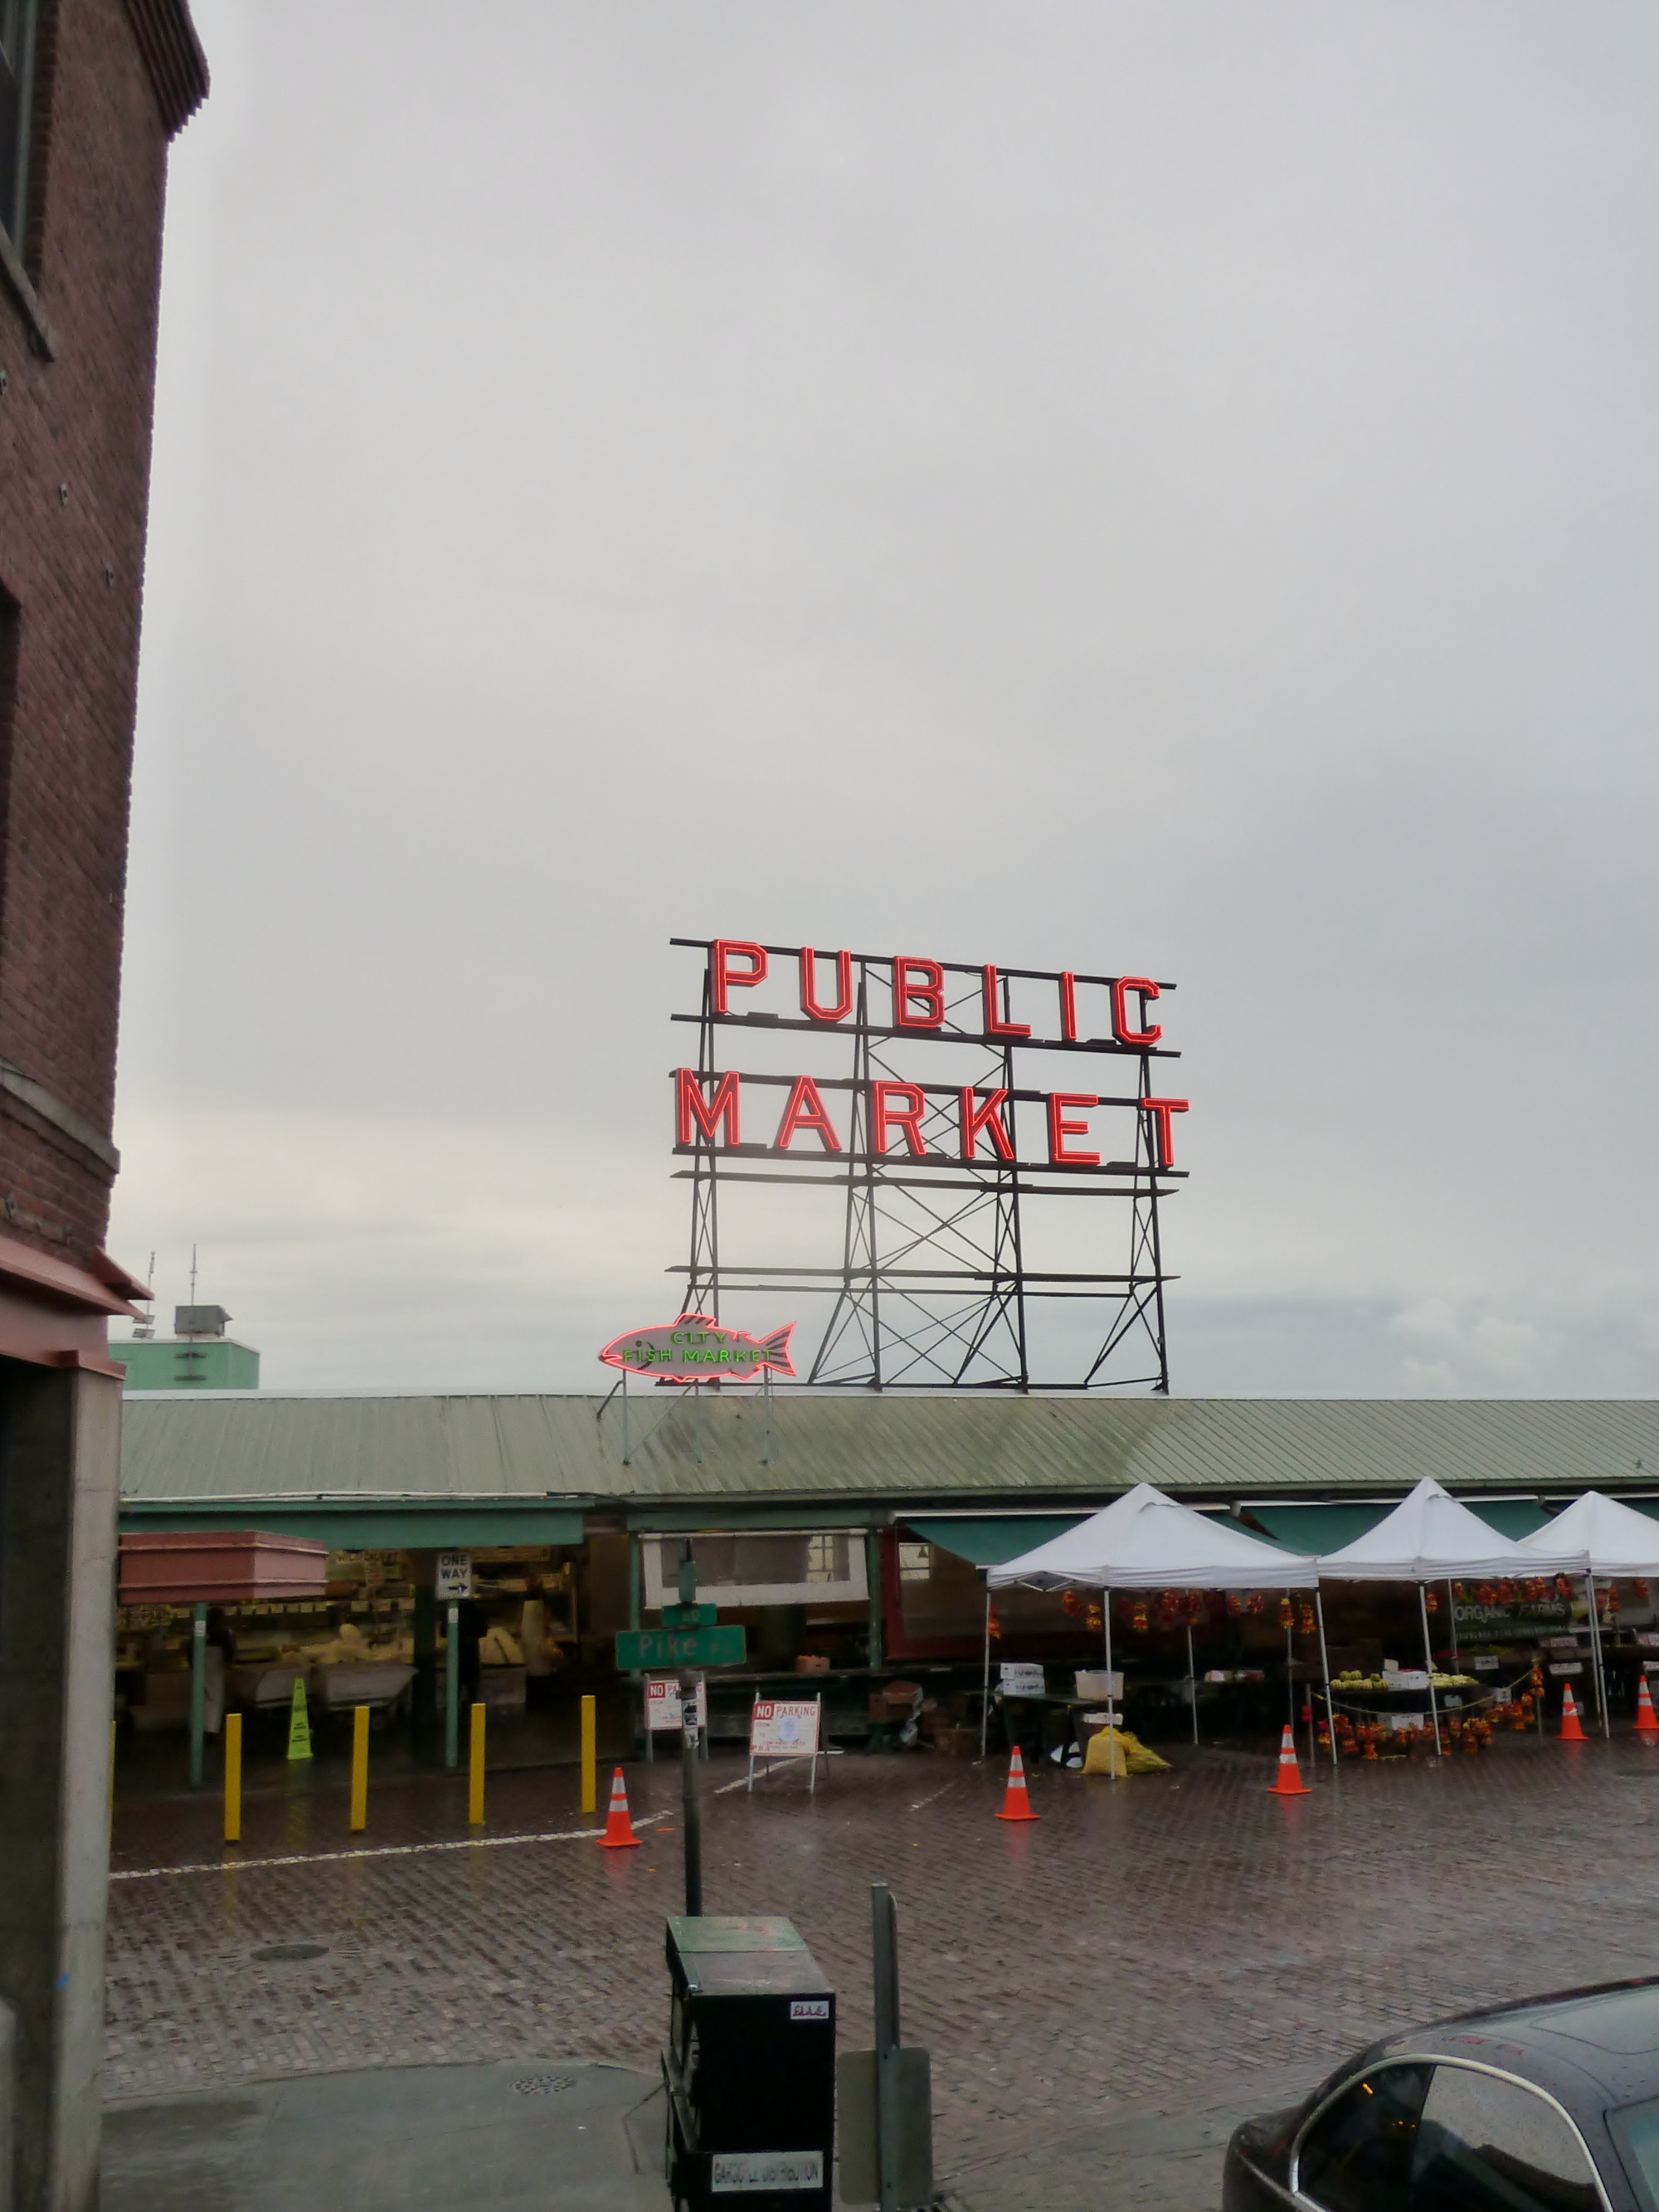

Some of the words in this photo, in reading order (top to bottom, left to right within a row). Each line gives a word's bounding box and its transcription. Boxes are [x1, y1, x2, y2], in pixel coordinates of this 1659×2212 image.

[711, 938, 1163, 1045] PUBLIC
[674, 1067, 1190, 1167] MARKET
[671, 1331, 727, 1344] CITY
[622, 1349, 673, 1363] FISH
[683, 1349, 773, 1363] MARKET
[441, 1554, 468, 1566] ONE
[440, 1568, 468, 1579] WAY
[1455, 1605, 1514, 1623] ORGANC
[639, 1634, 698, 1659] Pike
[649, 1683, 664, 1697] NO
[757, 1705, 772, 1718] NO
[776, 1706, 815, 1716] PARKING
